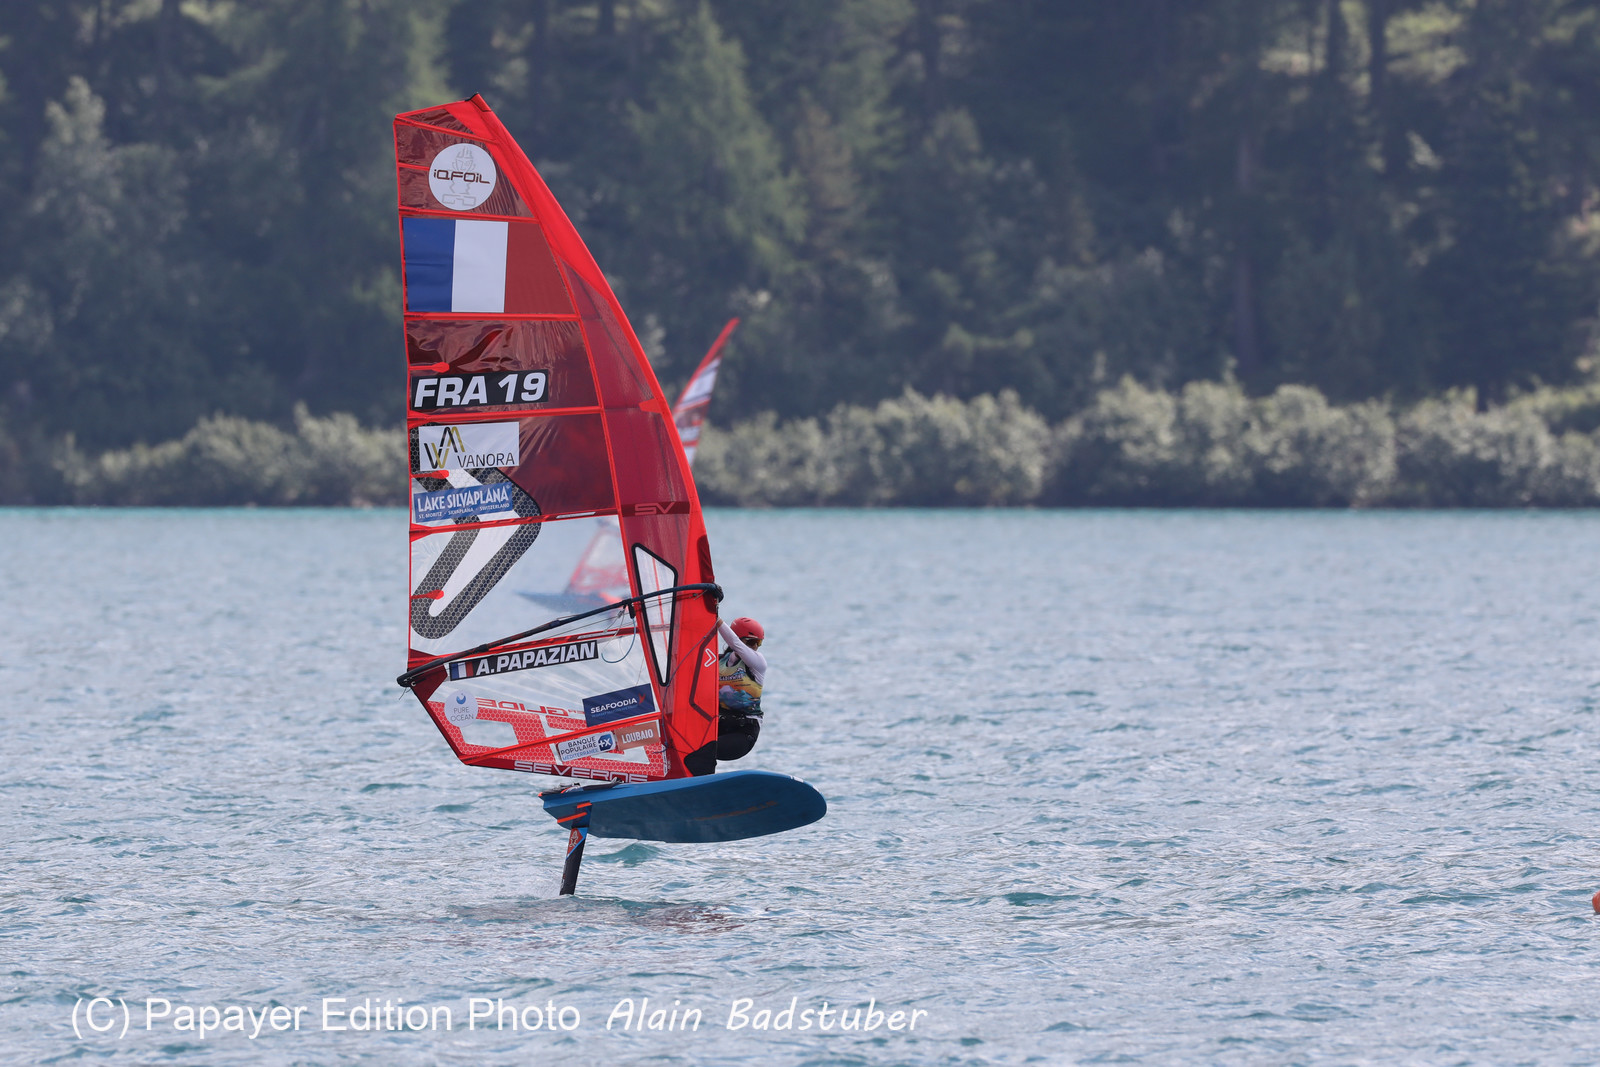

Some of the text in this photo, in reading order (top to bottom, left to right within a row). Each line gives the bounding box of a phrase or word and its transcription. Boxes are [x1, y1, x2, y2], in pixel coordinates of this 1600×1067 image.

[414, 372, 547, 408] FRA 19
[457, 452, 515, 468] VANORA
[417, 485, 510, 513] LAKE SILVAPLANA
[475, 641, 597, 677] A.PAPAZIAN
[453, 706, 470, 714] PURE
[590, 697, 638, 714] SEAFOODIA
[450, 713, 474, 722] OCEAN
[567, 735, 596, 749] BANQUE
[621, 728, 654, 744] LOUBAIO
[560, 741, 598, 756] POPULAIRE
[513, 759, 648, 784] SEVERNE
